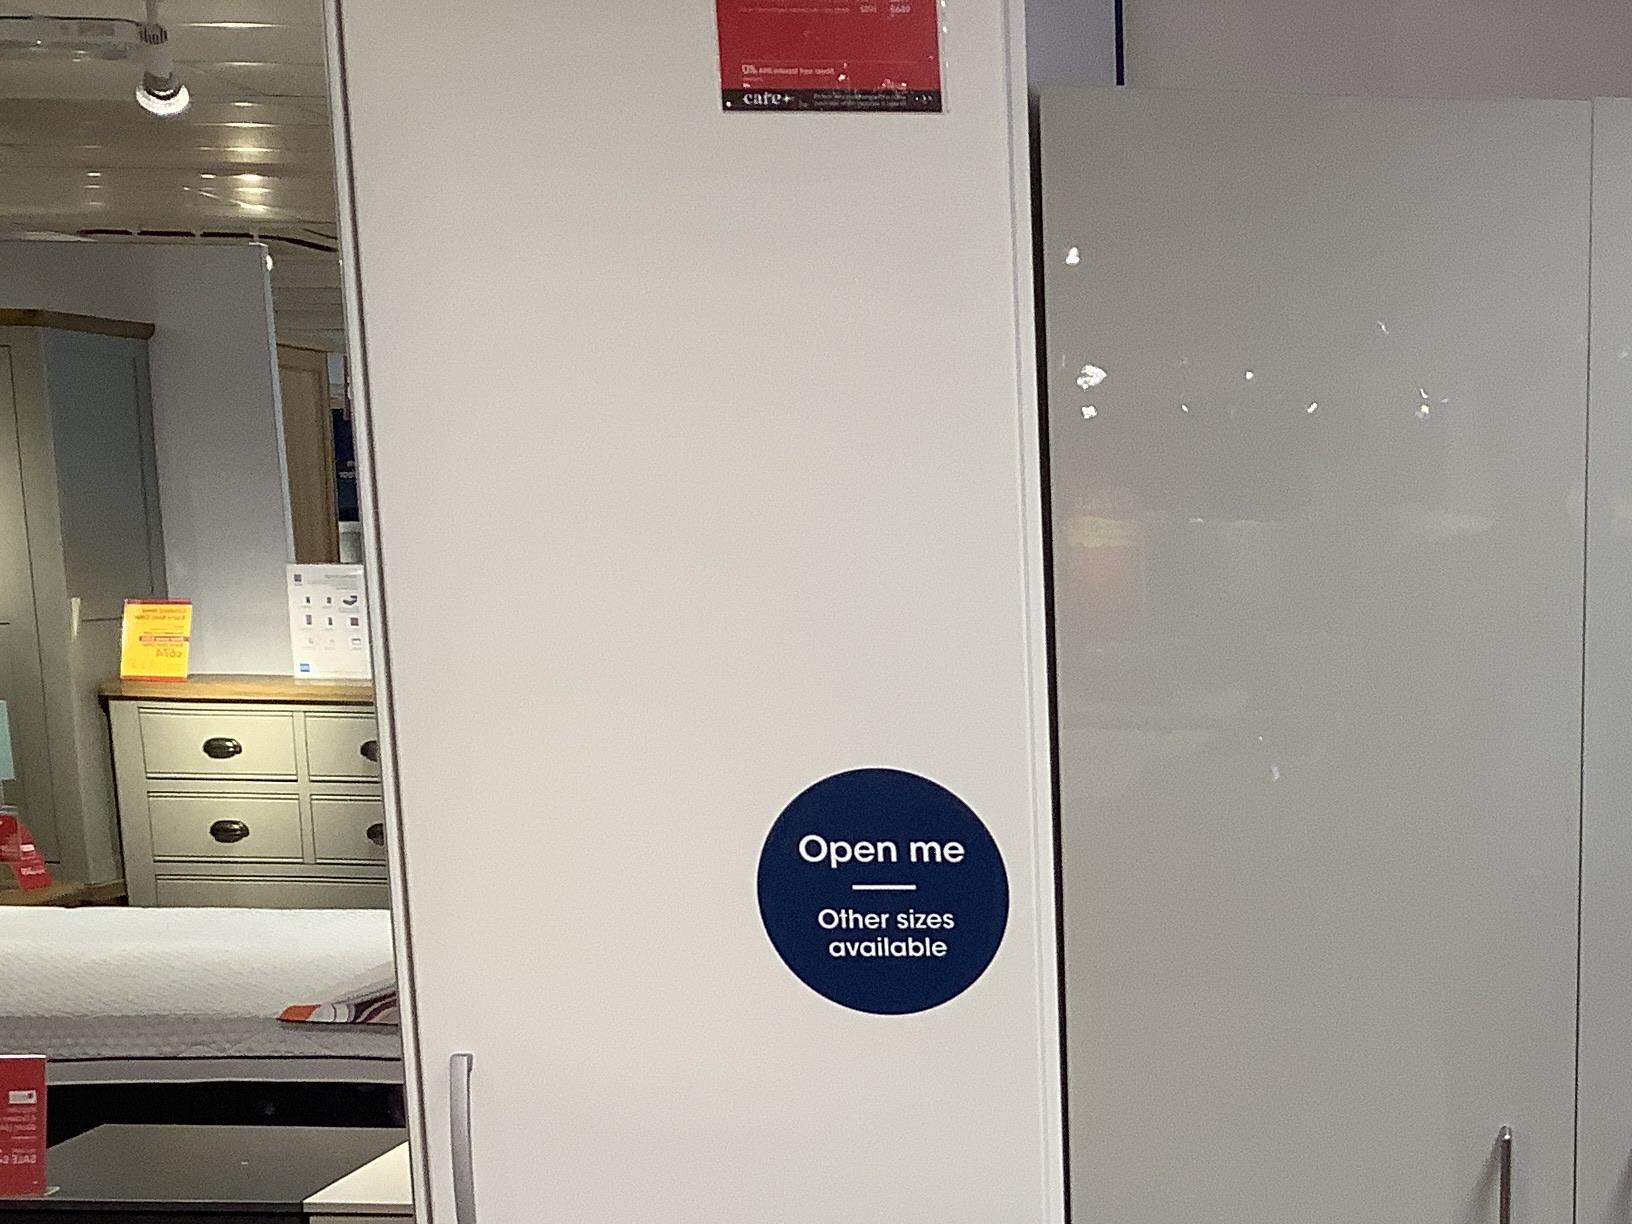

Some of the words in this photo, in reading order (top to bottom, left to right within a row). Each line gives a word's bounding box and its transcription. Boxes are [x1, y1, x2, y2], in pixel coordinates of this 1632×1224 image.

[799, 835, 897, 868] Open
[909, 841, 965, 863] me
[818, 909, 889, 929] Other
[897, 909, 955, 929] sizes
[829, 937, 947, 957] available
